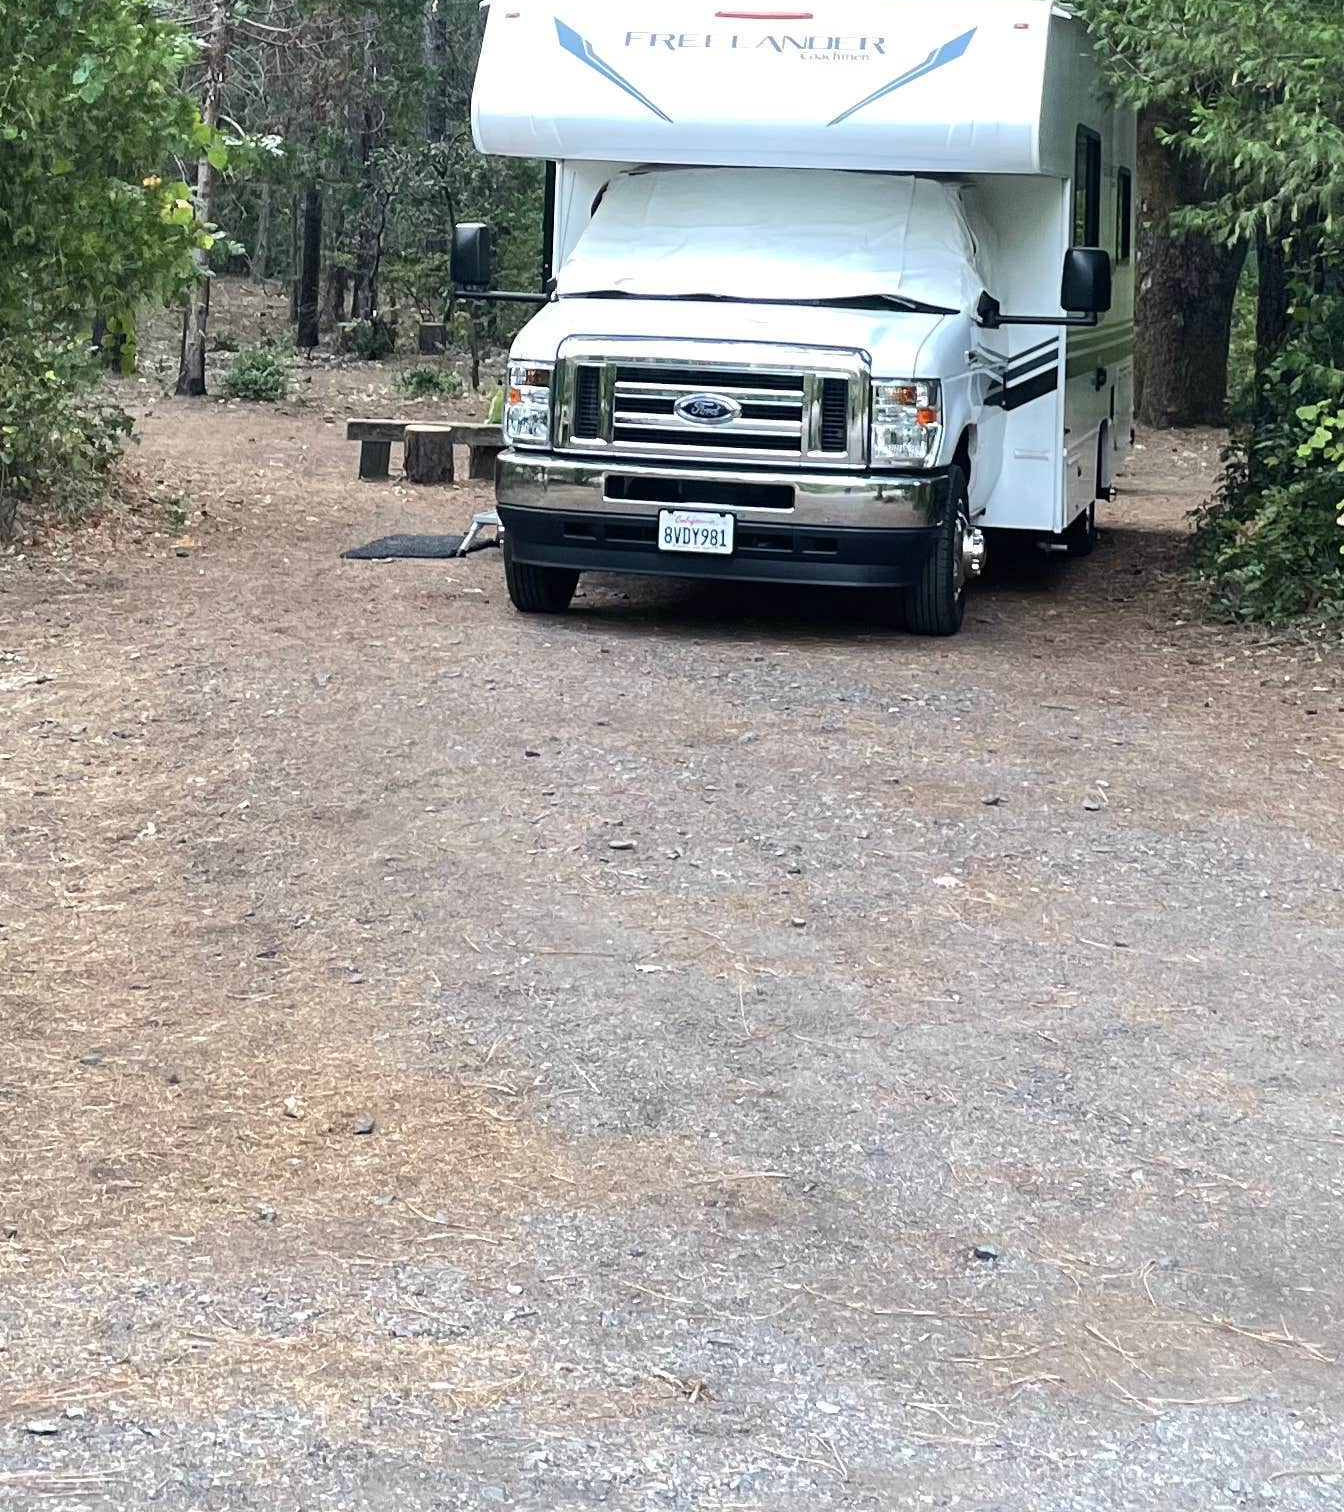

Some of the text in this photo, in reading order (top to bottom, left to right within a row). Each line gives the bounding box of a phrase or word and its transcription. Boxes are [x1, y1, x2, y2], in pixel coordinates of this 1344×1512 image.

[624, 31, 886, 55] FREELANDER
[691, 401, 722, 416] Ford
[664, 526, 727, 547] 8VDY981
